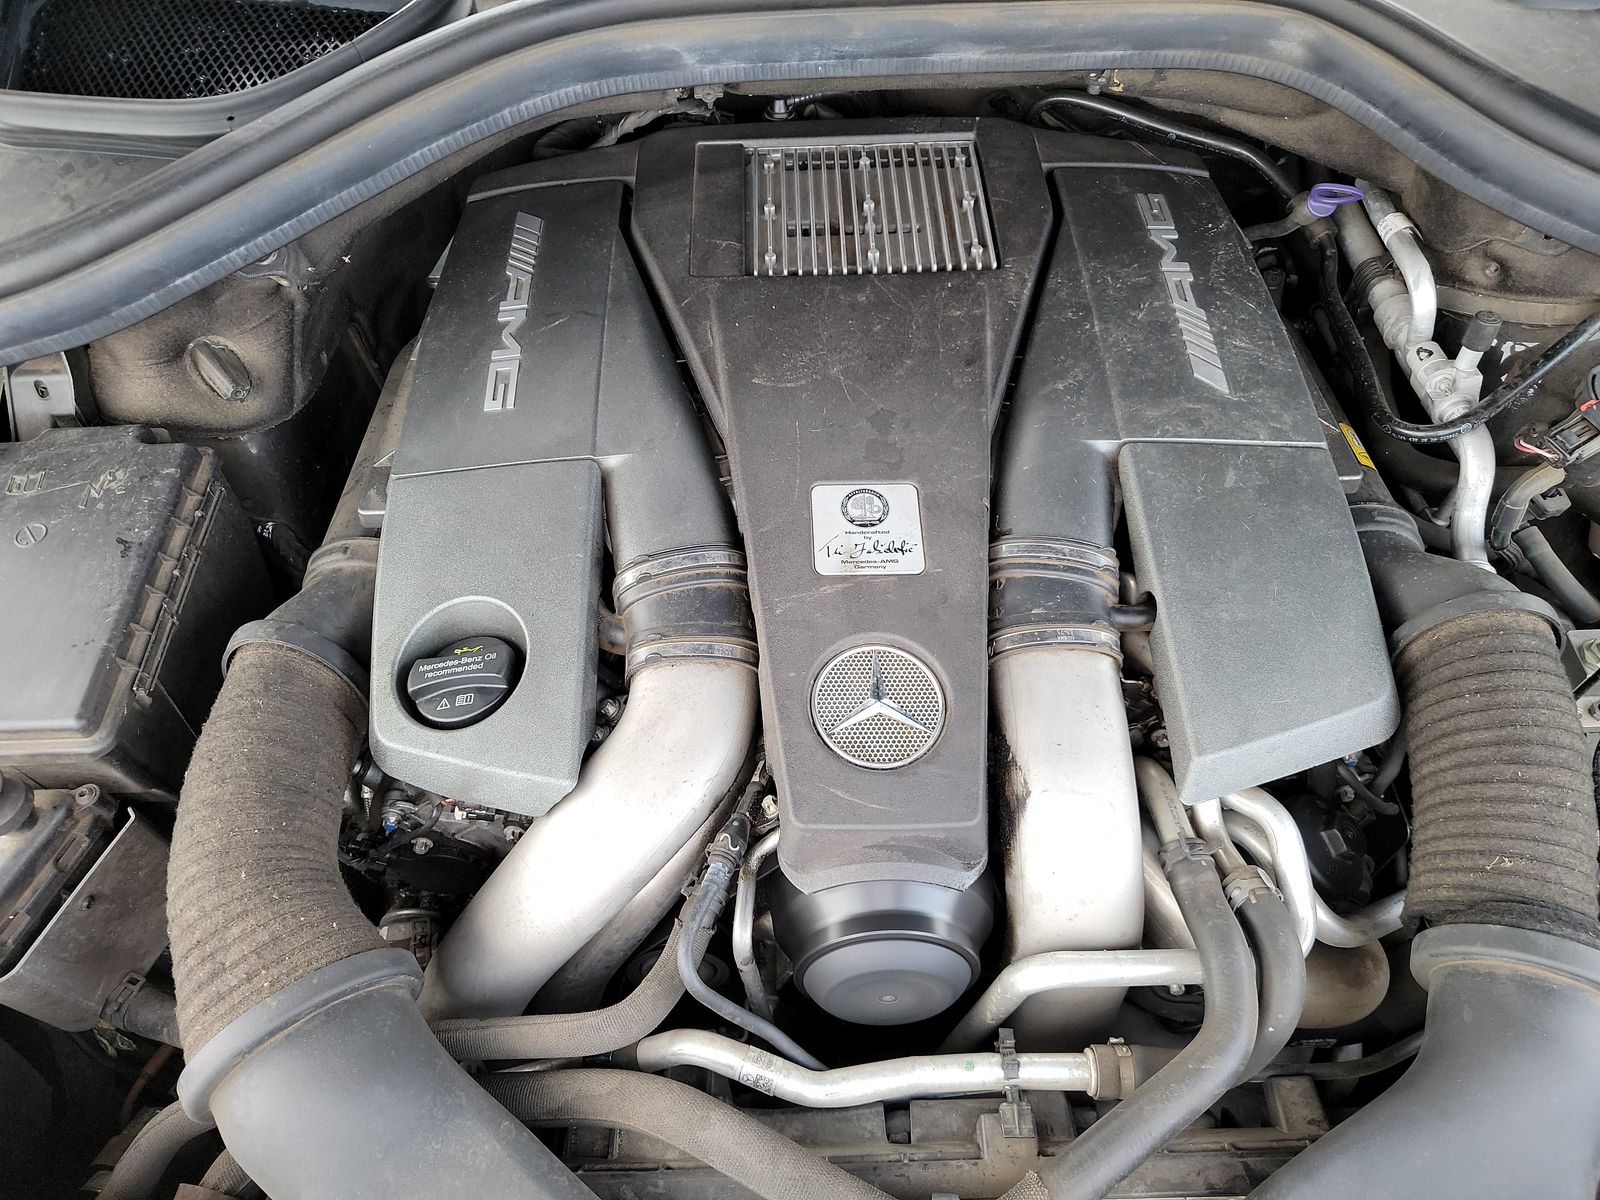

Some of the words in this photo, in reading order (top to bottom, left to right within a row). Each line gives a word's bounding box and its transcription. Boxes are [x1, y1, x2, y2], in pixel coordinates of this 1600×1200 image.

[419, 655, 483, 672] Mercedes-Benz
[484, 652, 497, 661] Oil
[424, 662, 484, 679] recommended
